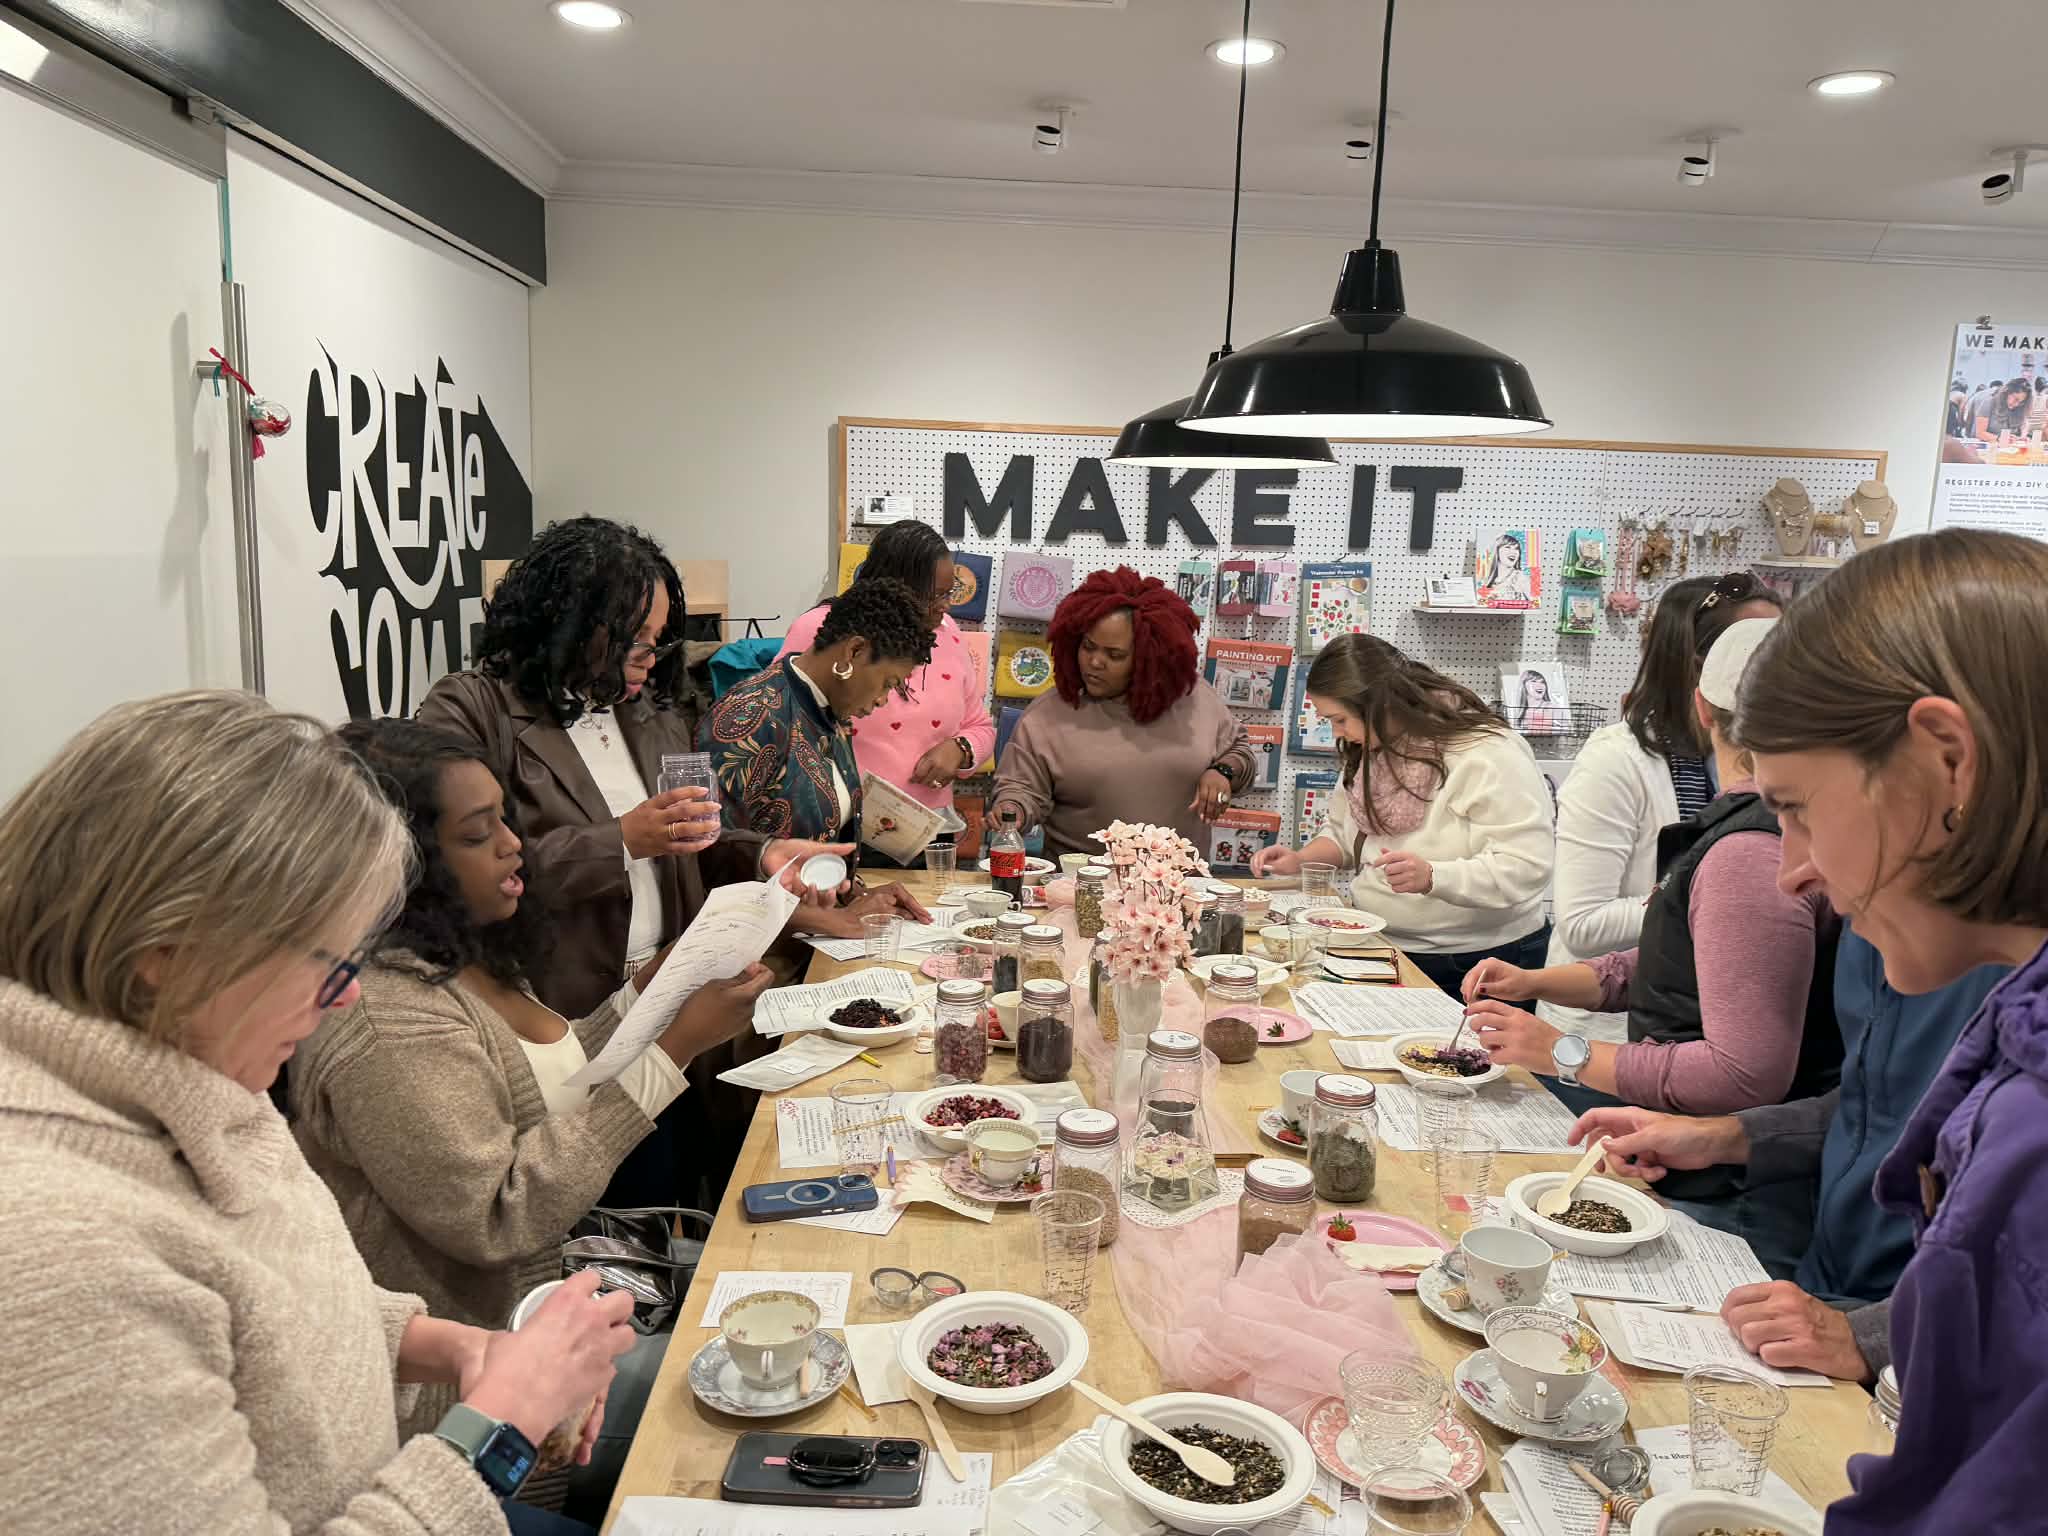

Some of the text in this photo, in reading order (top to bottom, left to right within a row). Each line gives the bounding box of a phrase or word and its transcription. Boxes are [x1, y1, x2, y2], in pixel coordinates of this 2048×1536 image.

[1965, 334, 2048, 350] WE MAK
[943, 452, 1464, 552] MAKE IT
[1216, 649, 1283, 663] PAINTING KIT
